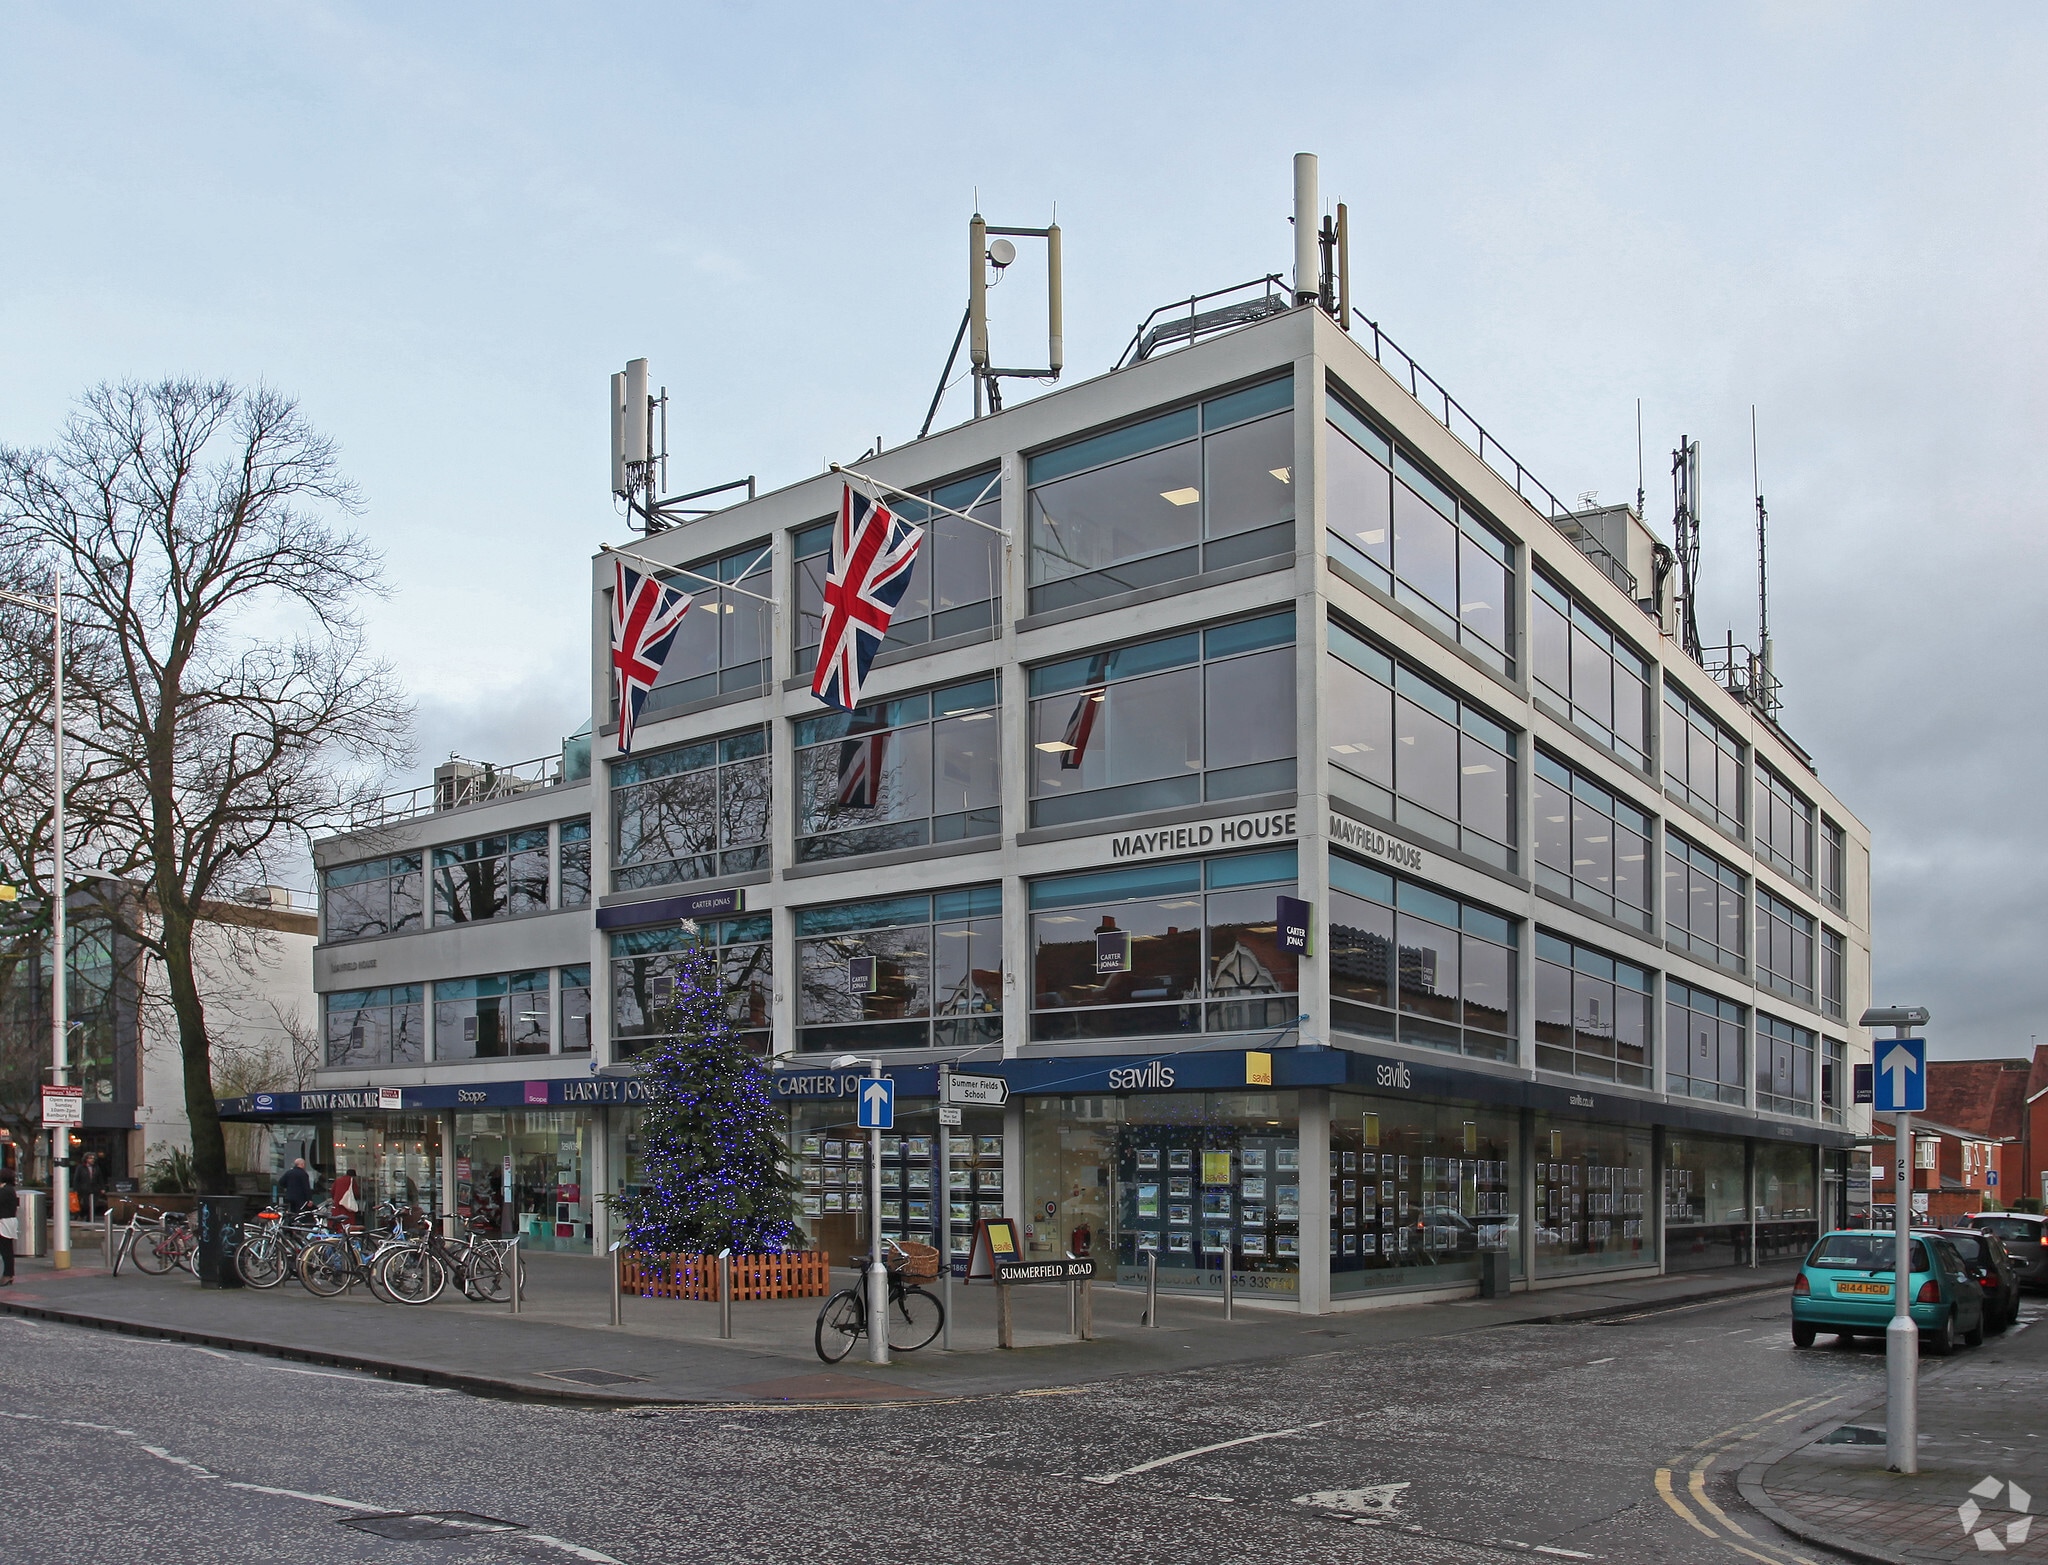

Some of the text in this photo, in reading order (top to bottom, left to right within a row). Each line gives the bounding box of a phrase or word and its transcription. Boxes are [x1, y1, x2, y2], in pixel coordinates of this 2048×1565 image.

[1112, 813, 1296, 857] MAYFIELD HOUSE
[1329, 815, 1422, 870] MAYFIELD HOUSE
[691, 897, 731, 909] CARTER JONAS
[1286, 926, 1306, 937] CARTER
[1286, 936, 1304, 947] JONAS
[1100, 953, 1121, 961] CARTER
[1100, 961, 1119, 970] JONAS
[1108, 1061, 1175, 1089] savills
[1252, 1072, 1271, 1083] savills
[1376, 1061, 1411, 1090] savills
[778, 1075, 835, 1095] CARTER
[952, 1078, 978, 1088] Summer
[980, 1081, 998, 1090] Fields
[458, 1089, 487, 1104] Scope
[564, 1081, 619, 1101] HARVEY
[965, 1090, 986, 1099] School
[301, 1094, 328, 1110] PENNY
[330, 1094, 337, 1109] &
[338, 1092, 379, 1108] SINCLAIR
[1898, 1159, 1904, 1169] 2
[1898, 1172, 1905, 1181] S
[994, 1242, 1012, 1251] savills
[1001, 1263, 1093, 1280] SUMMERFIELD ROAD
[1209, 1273, 1246, 1288] 0165
[1840, 1284, 1863, 1292] R144
